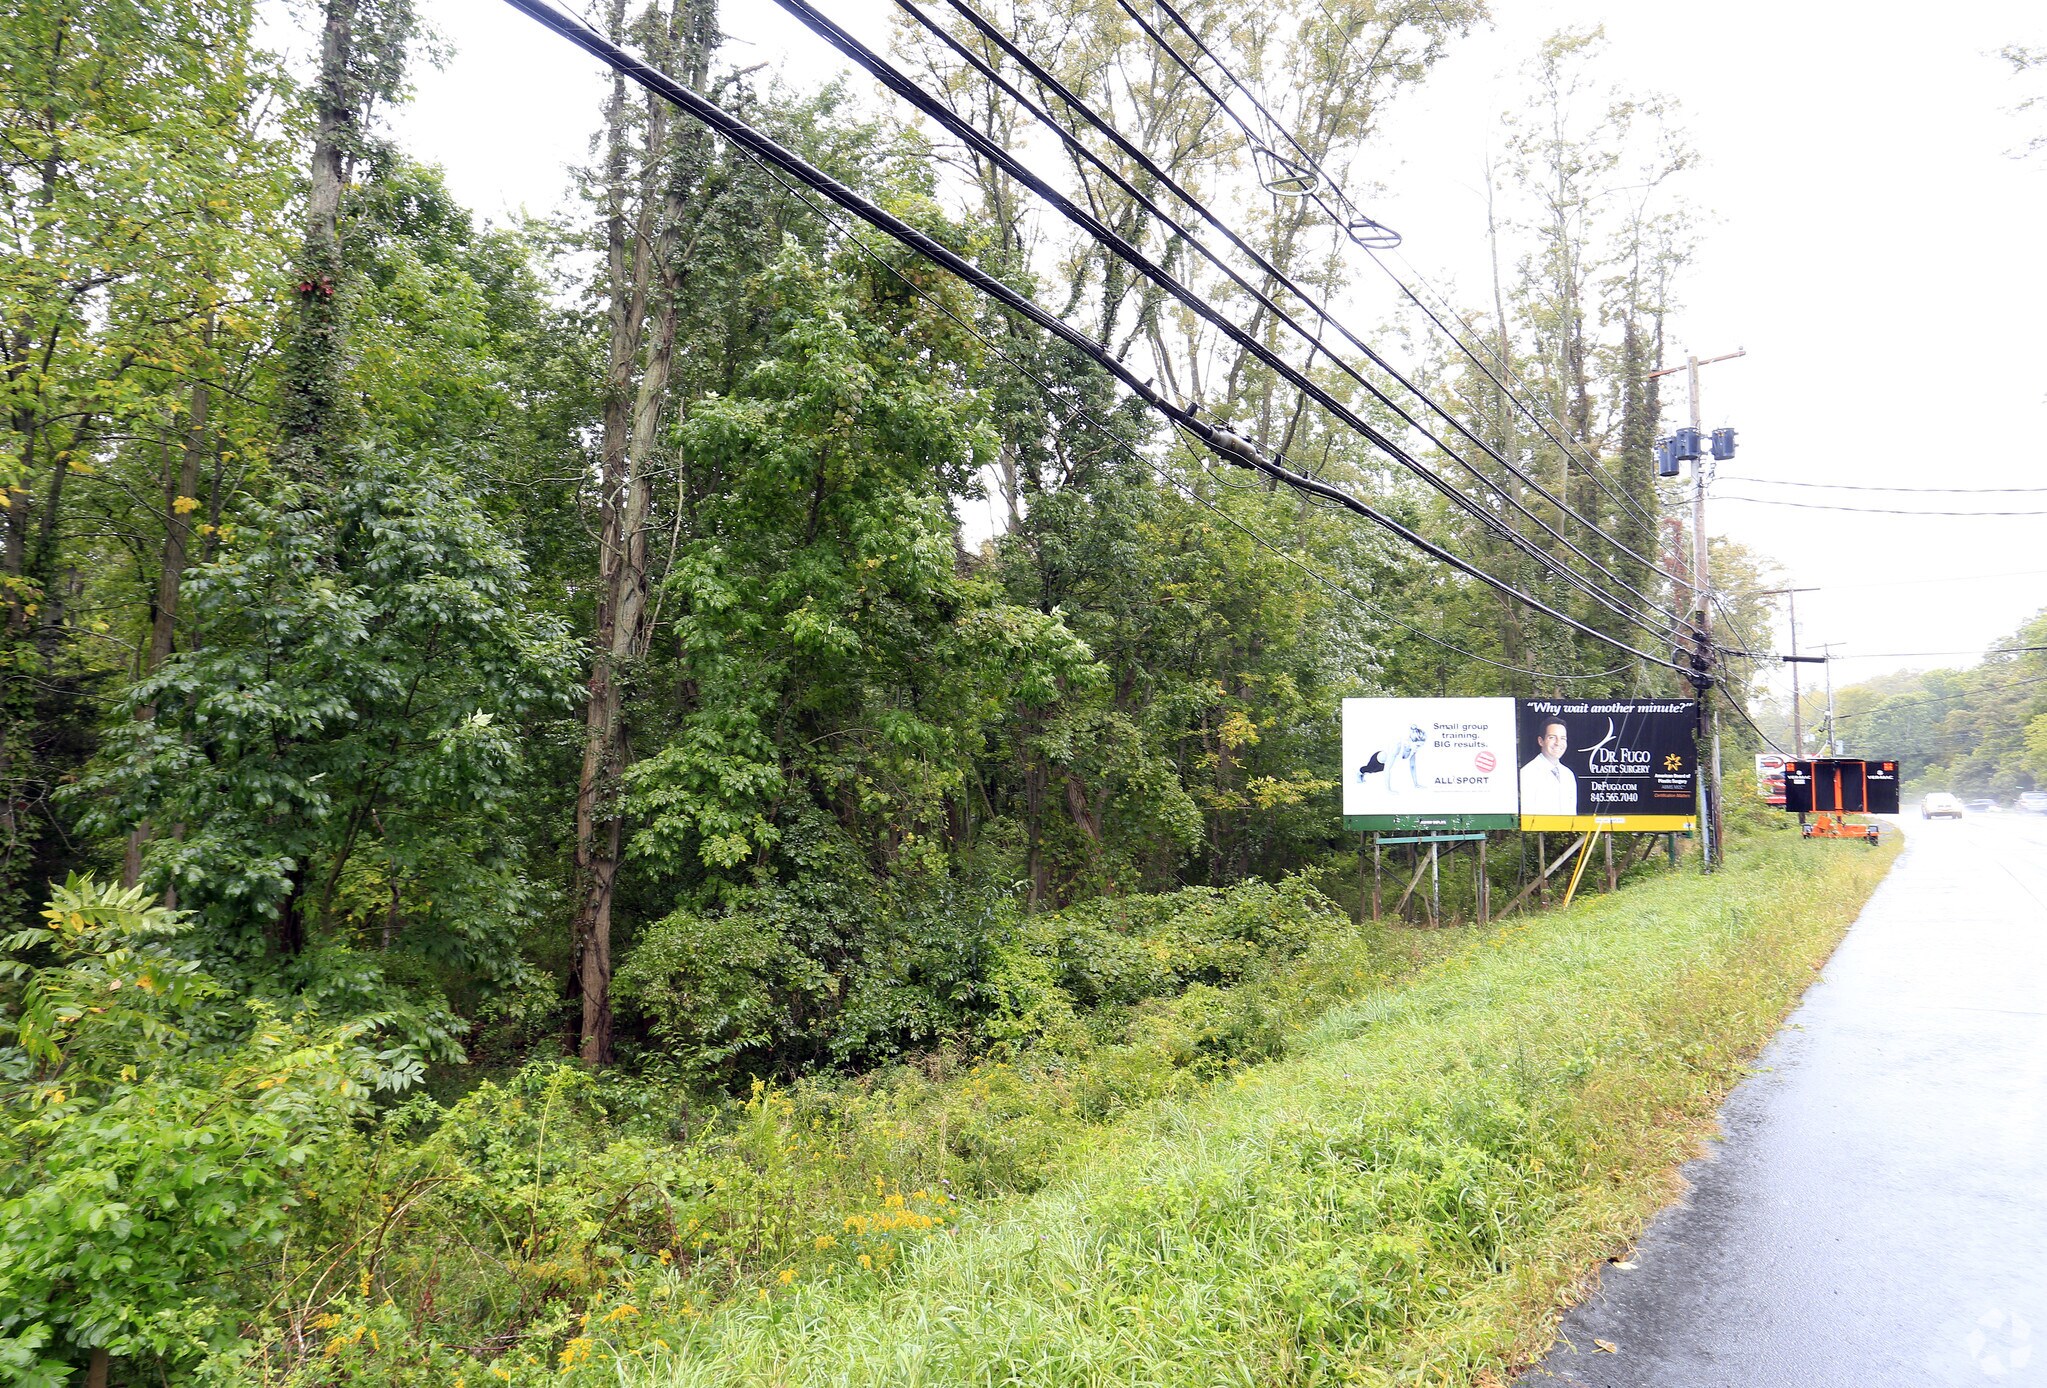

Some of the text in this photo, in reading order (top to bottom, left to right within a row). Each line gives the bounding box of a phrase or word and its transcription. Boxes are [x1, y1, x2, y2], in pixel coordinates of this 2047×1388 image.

[1563, 702, 1589, 713] wait
[1590, 702, 1635, 713] another
[1433, 722, 1459, 730] Small
[1442, 732, 1480, 740] training.
[1434, 740, 1451, 748] BIG
[1434, 776, 1489, 785] ALL SPORT
[1590, 792, 1639, 802] 845.565.7040
